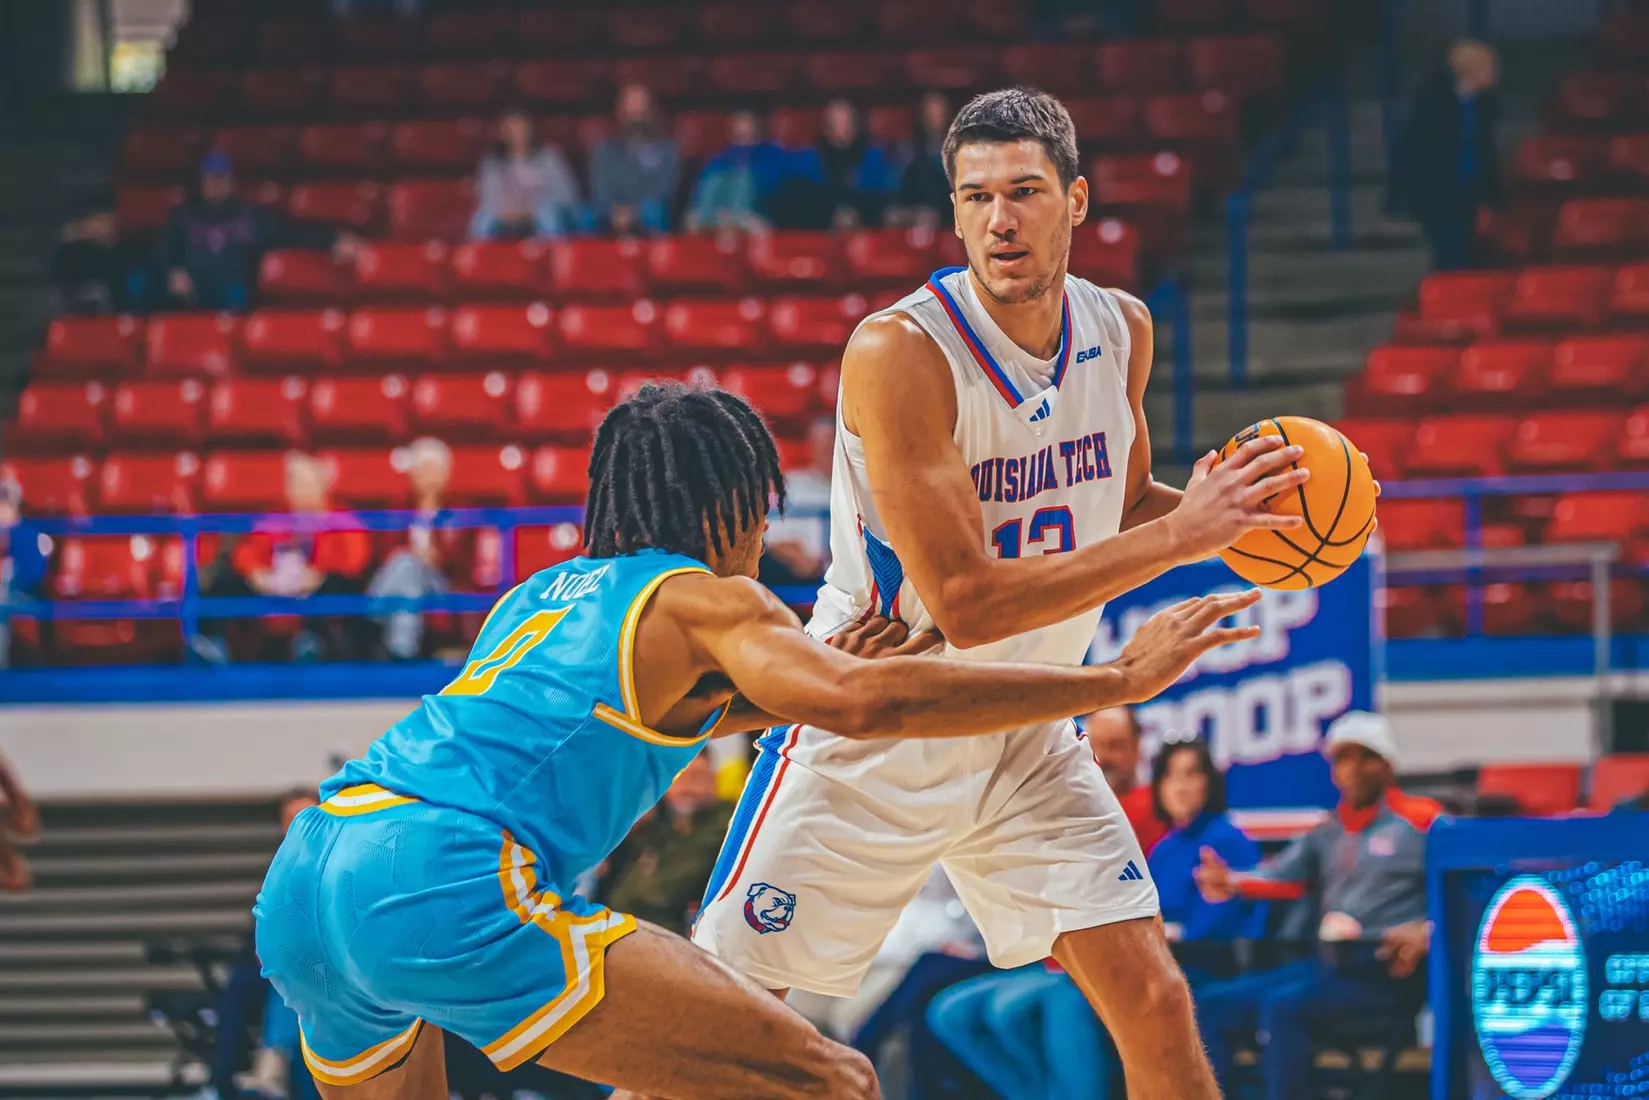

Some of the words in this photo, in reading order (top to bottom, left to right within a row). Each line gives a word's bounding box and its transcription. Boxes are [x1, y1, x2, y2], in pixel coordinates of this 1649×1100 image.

[1059, 432, 1113, 488] TECH
[539, 563, 611, 602] NOEL
[437, 602, 577, 696] 0
